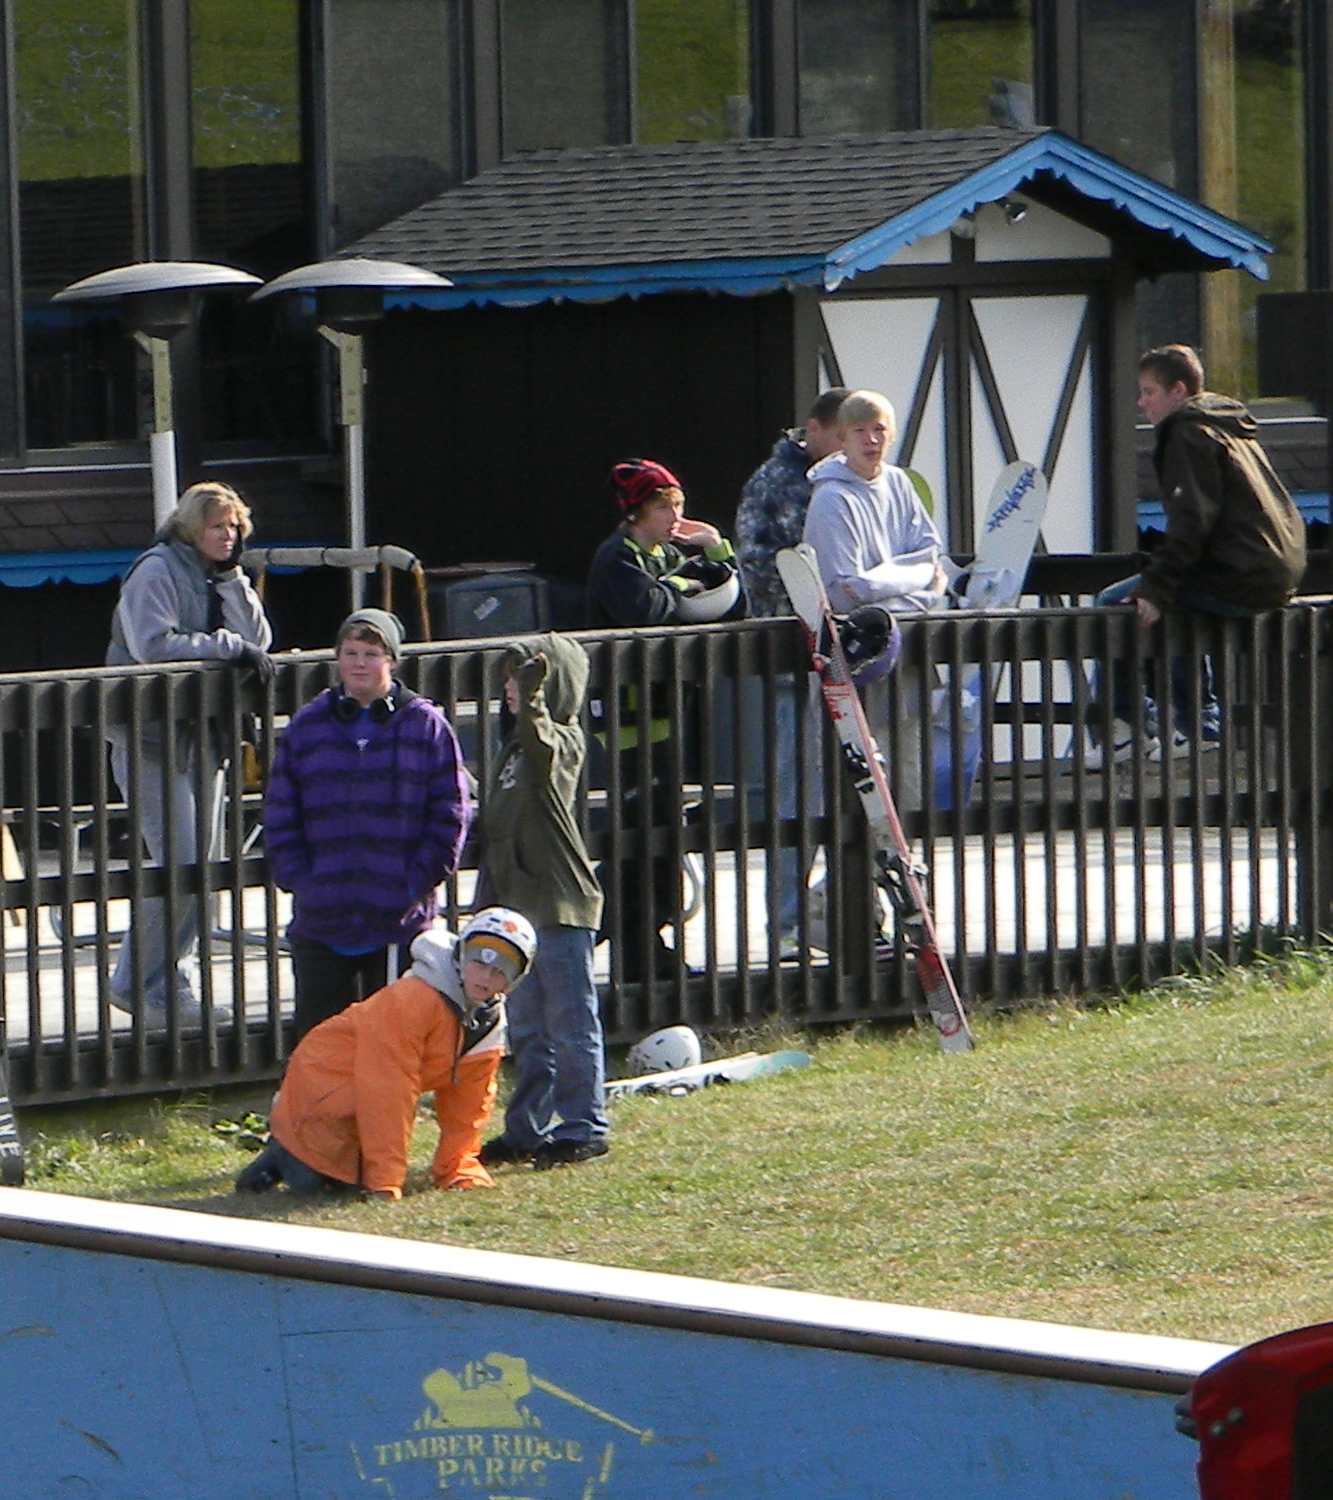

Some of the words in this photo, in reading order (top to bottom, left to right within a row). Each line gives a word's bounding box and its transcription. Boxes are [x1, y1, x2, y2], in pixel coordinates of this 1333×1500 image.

[373, 1434, 484, 1466] TIMBER
[491, 1433, 583, 1463] RIDGE
[437, 1457, 548, 1489] PARKS
